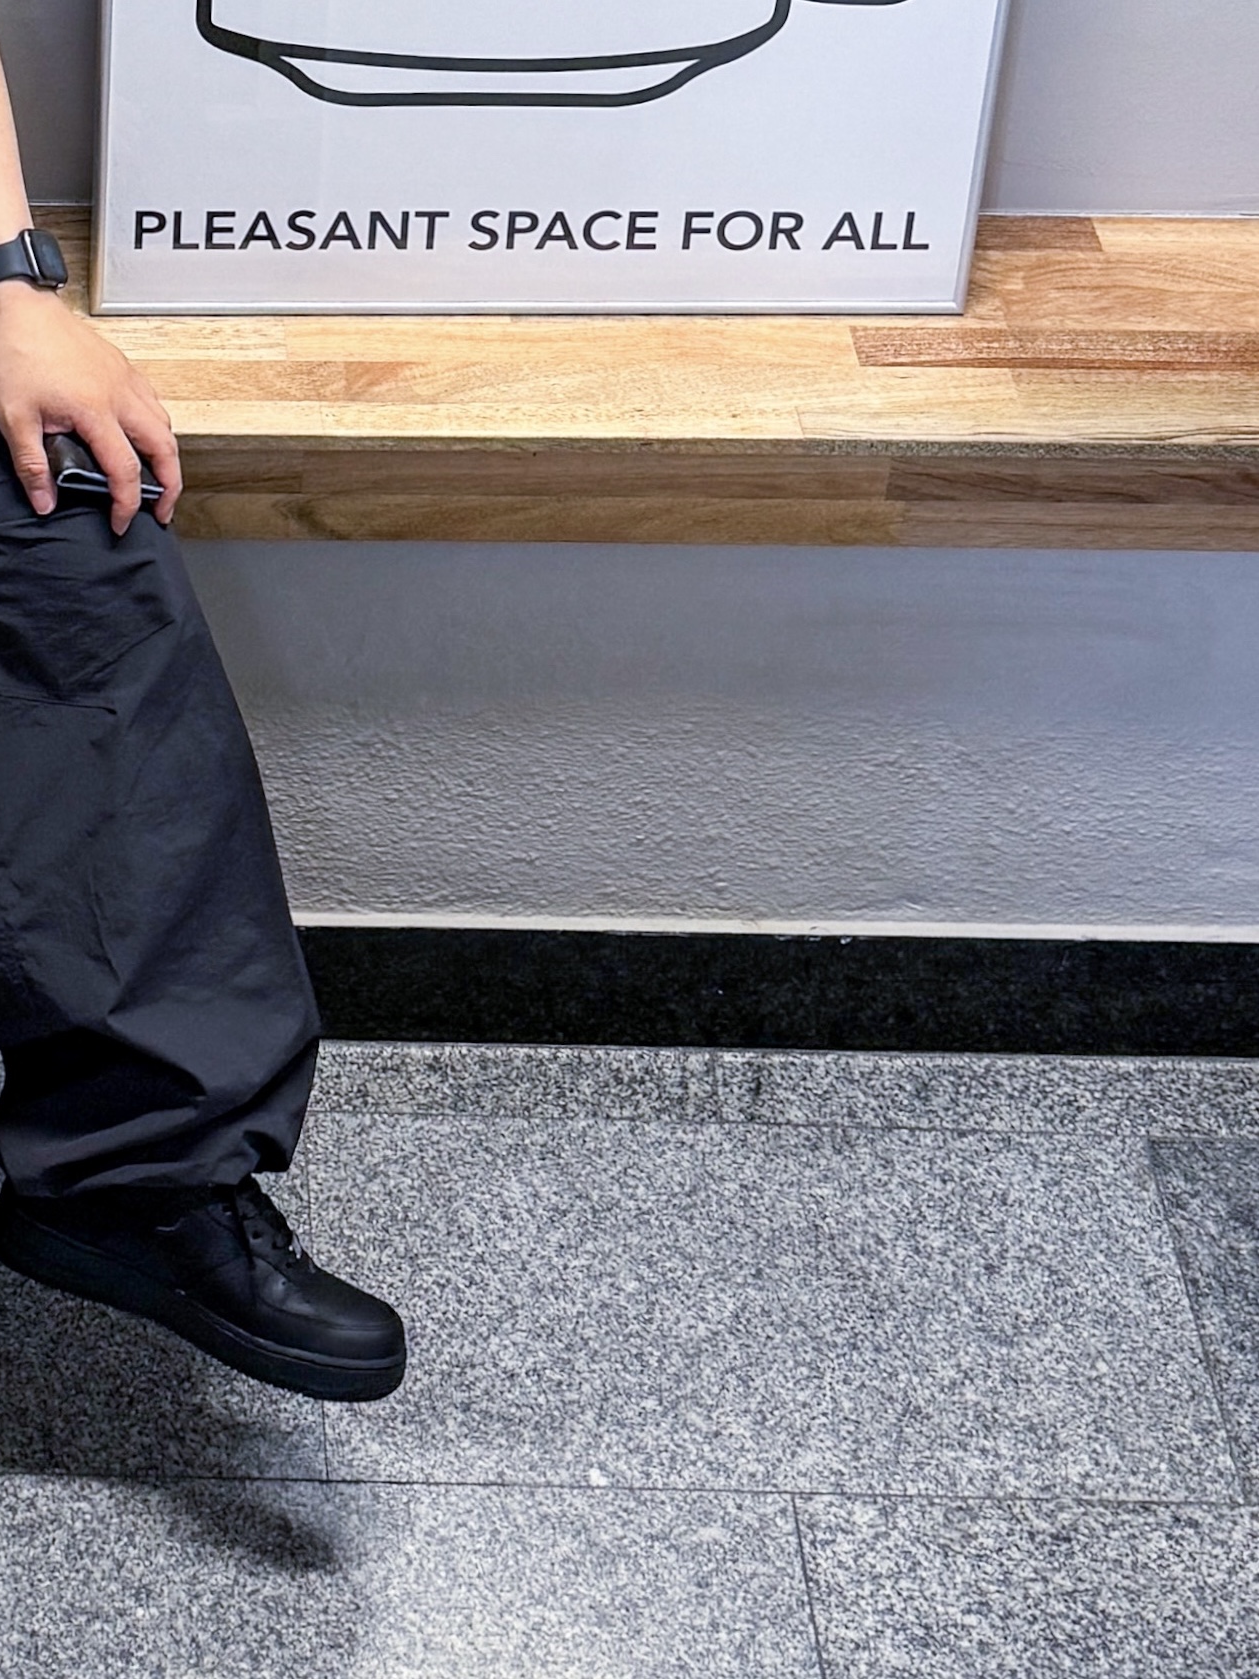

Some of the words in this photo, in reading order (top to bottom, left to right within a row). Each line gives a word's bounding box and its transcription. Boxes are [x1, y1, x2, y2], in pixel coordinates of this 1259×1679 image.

[134, 209, 451, 251] PLEASANT
[468, 209, 659, 251] SPACE
[681, 210, 804, 251] FOR
[821, 211, 930, 251] ALL
